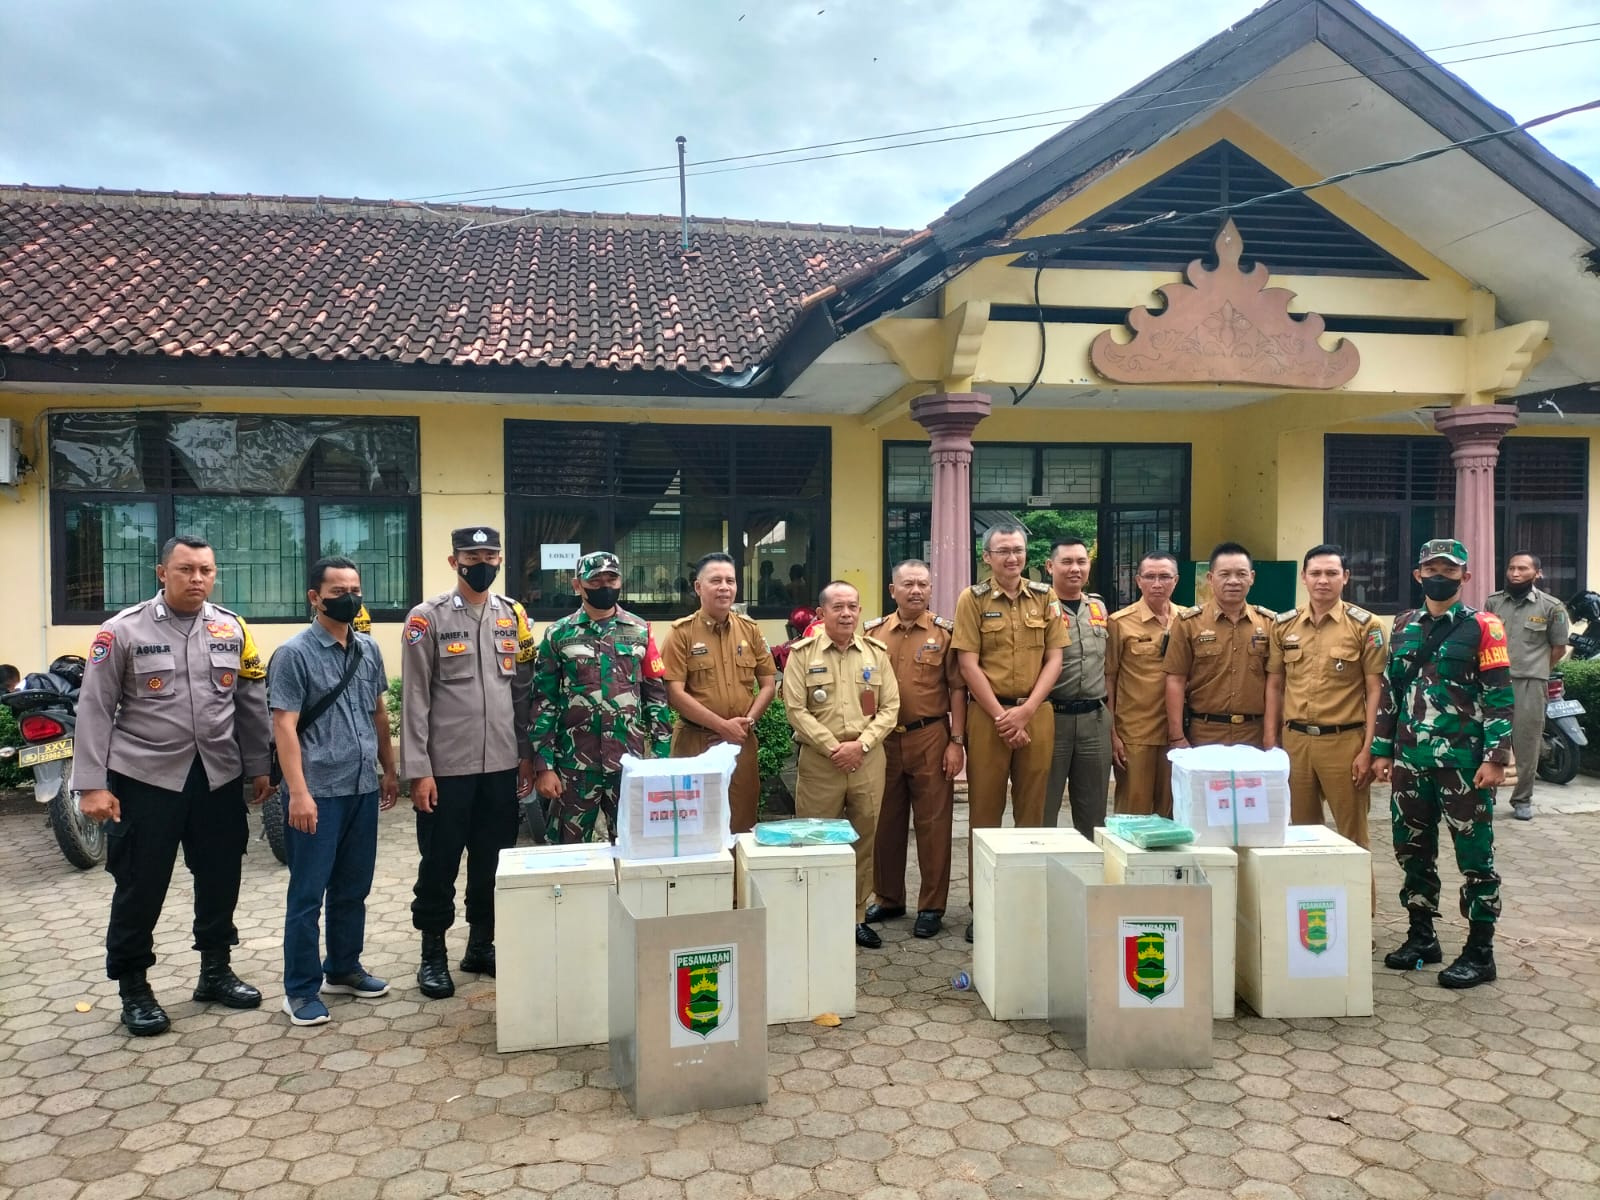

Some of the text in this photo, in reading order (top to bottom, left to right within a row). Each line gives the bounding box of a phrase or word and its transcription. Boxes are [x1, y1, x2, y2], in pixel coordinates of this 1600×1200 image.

[494, 630, 516, 638] POLRI
[209, 643, 239, 652] POLRI
[44, 741, 66, 752] XXV
[677, 952, 729, 967] PESAWARAN
